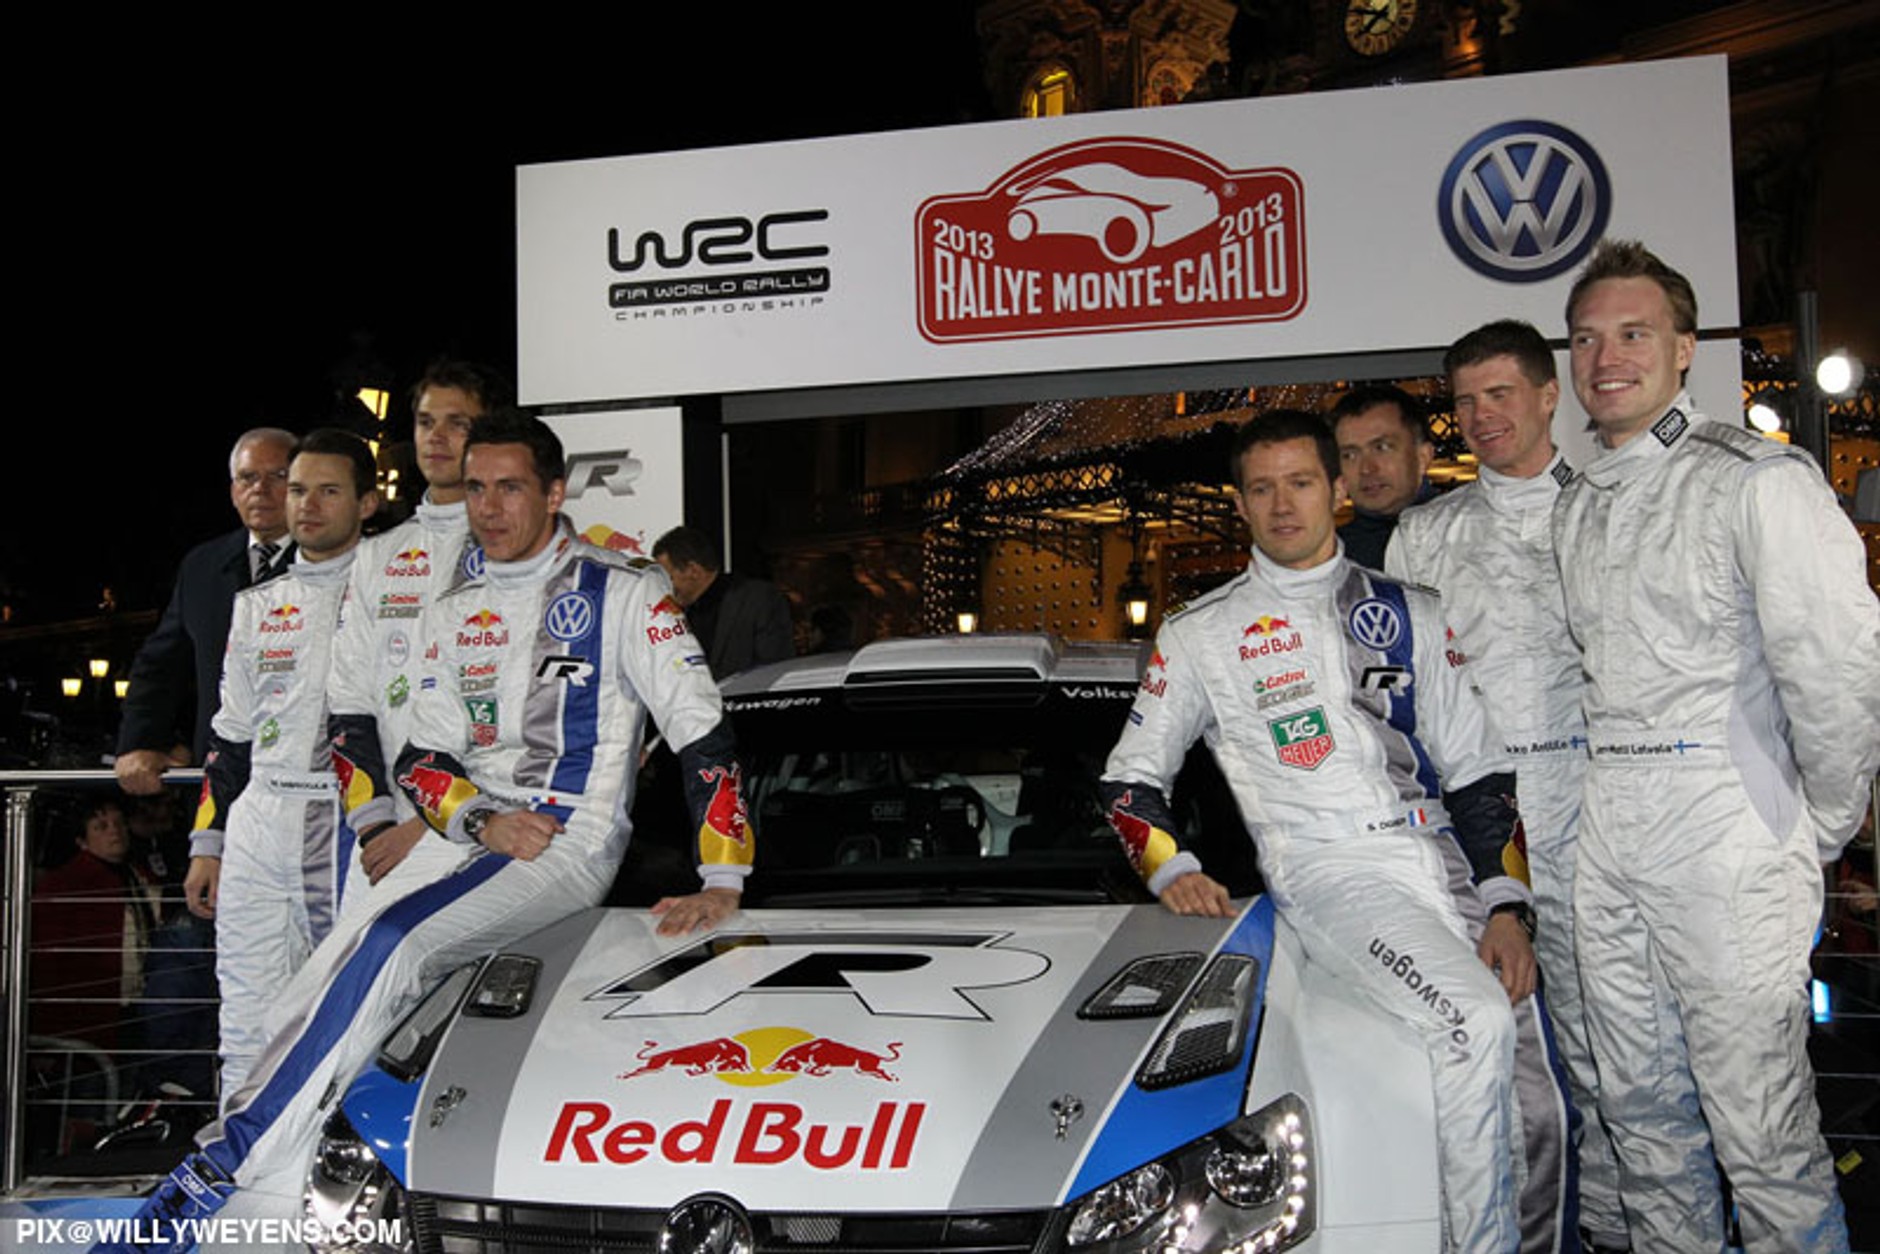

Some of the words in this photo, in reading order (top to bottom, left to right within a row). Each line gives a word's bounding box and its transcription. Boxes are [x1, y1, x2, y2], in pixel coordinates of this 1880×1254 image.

[1219, 193, 1283, 245] 2013
[608, 210, 830, 272] WRC
[933, 219, 995, 260] 2013
[934, 246, 1042, 321] RALLYE
[1053, 221, 1288, 313] MONTE-CARLO
[615, 289, 648, 301] FIA
[654, 281, 737, 299] WORLD
[743, 274, 825, 291] RALLY
[615, 297, 825, 321] CHAMPIONSHIP
[456, 631, 482, 648] Red
[484, 629, 509, 647] Bull
[646, 617, 685, 645] Red
[1239, 638, 1270, 661] Red
[1271, 632, 1304, 654] Bull
[1265, 668, 1307, 690] Castrol
[1279, 715, 1320, 742] TAG
[1279, 736, 1333, 768] HEUER
[1368, 937, 1472, 1068] Vokswagen
[544, 1098, 733, 1165] Red
[733, 1102, 927, 1170] Bull
